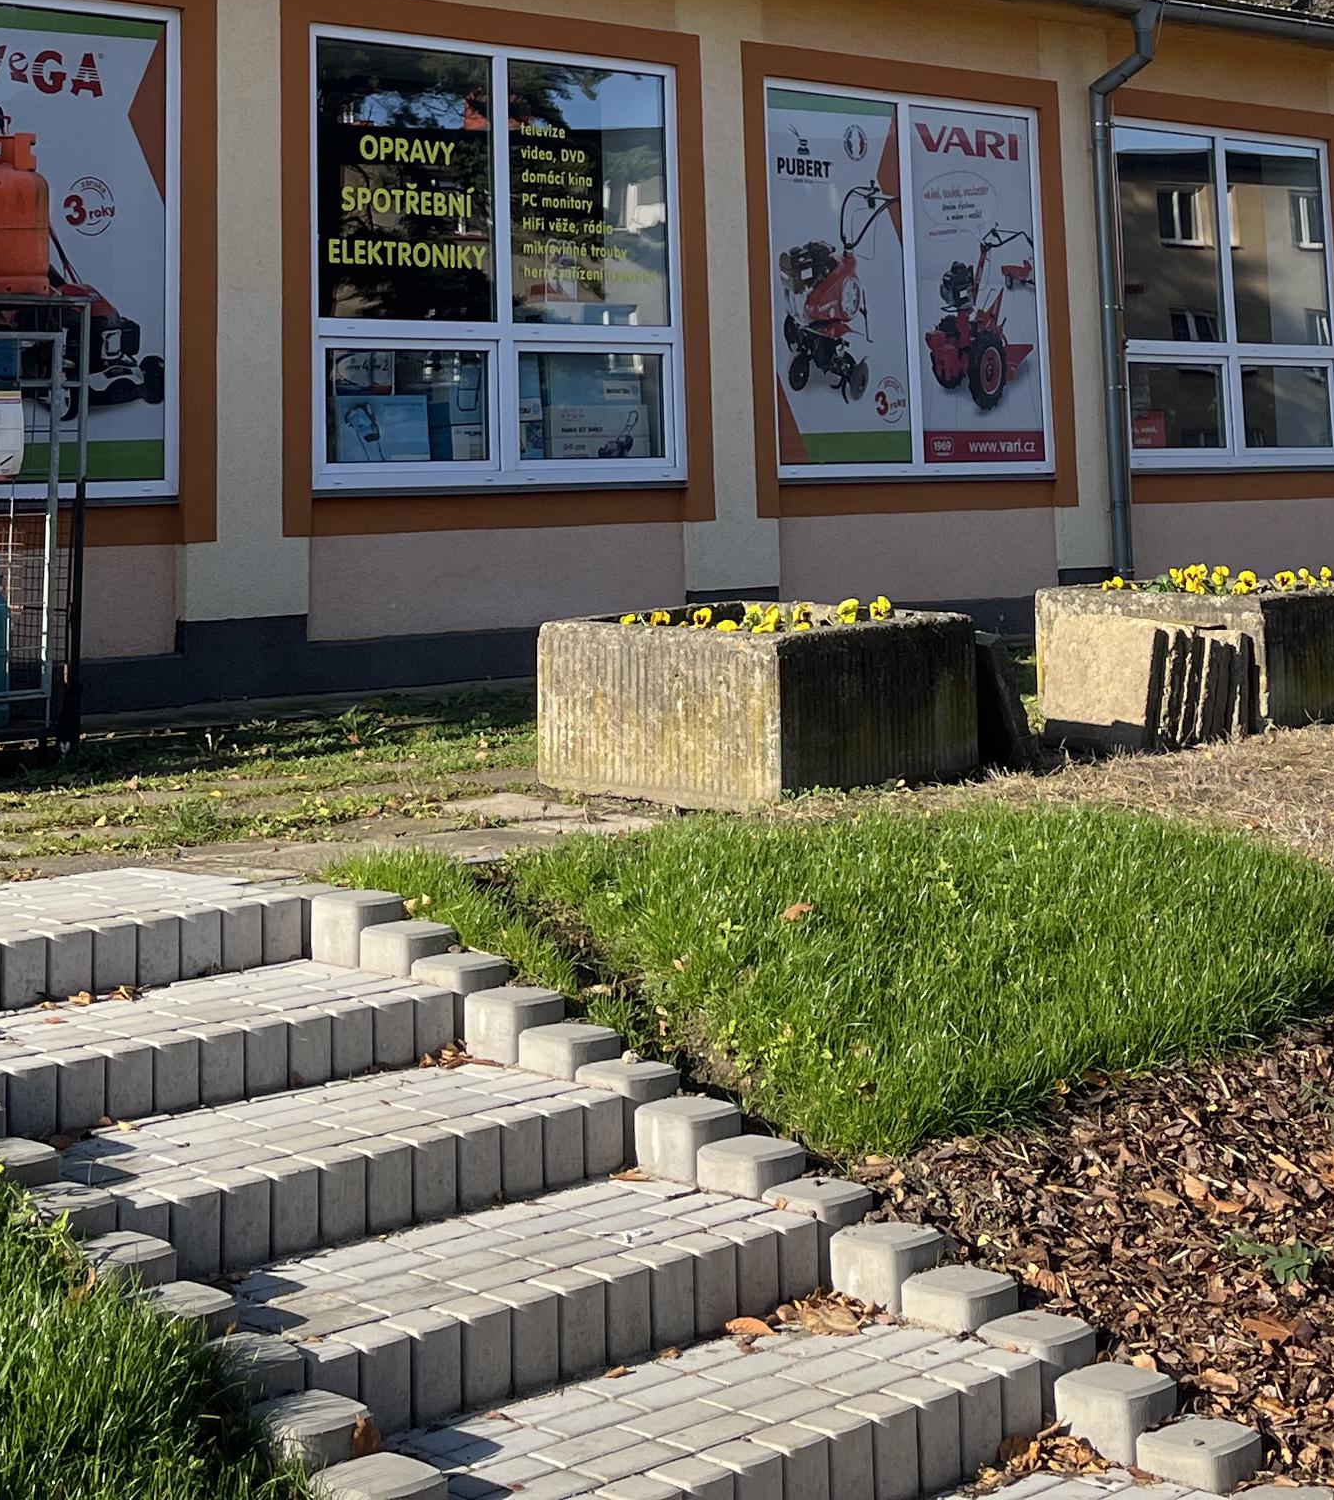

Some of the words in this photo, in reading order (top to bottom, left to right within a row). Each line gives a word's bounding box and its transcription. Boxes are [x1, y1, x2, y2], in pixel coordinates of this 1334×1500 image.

[520, 122, 566, 139] televize
[359, 134, 455, 166] OPRAVY
[914, 122, 1019, 161] VARI
[521, 146, 557, 164] videa,
[561, 148, 585, 163] DVD
[777, 156, 831, 178] PUBERT
[522, 169, 565, 185] domácí
[568, 172, 593, 187] kina
[64, 194, 87, 225] 3
[88, 205, 115, 220] roky
[340, 182, 475, 219] SPOTŘEBNÍ
[522, 193, 537, 206] PC
[542, 196, 593, 214] monitory
[522, 217, 545, 231] HiFi
[549, 218, 580, 235] věže,
[328, 238, 487, 270] ELEKTRONIKY
[591, 244, 628, 262] trouby
[874, 391, 889, 416] 3
[969, 438, 1036, 453] www.vari.cz
